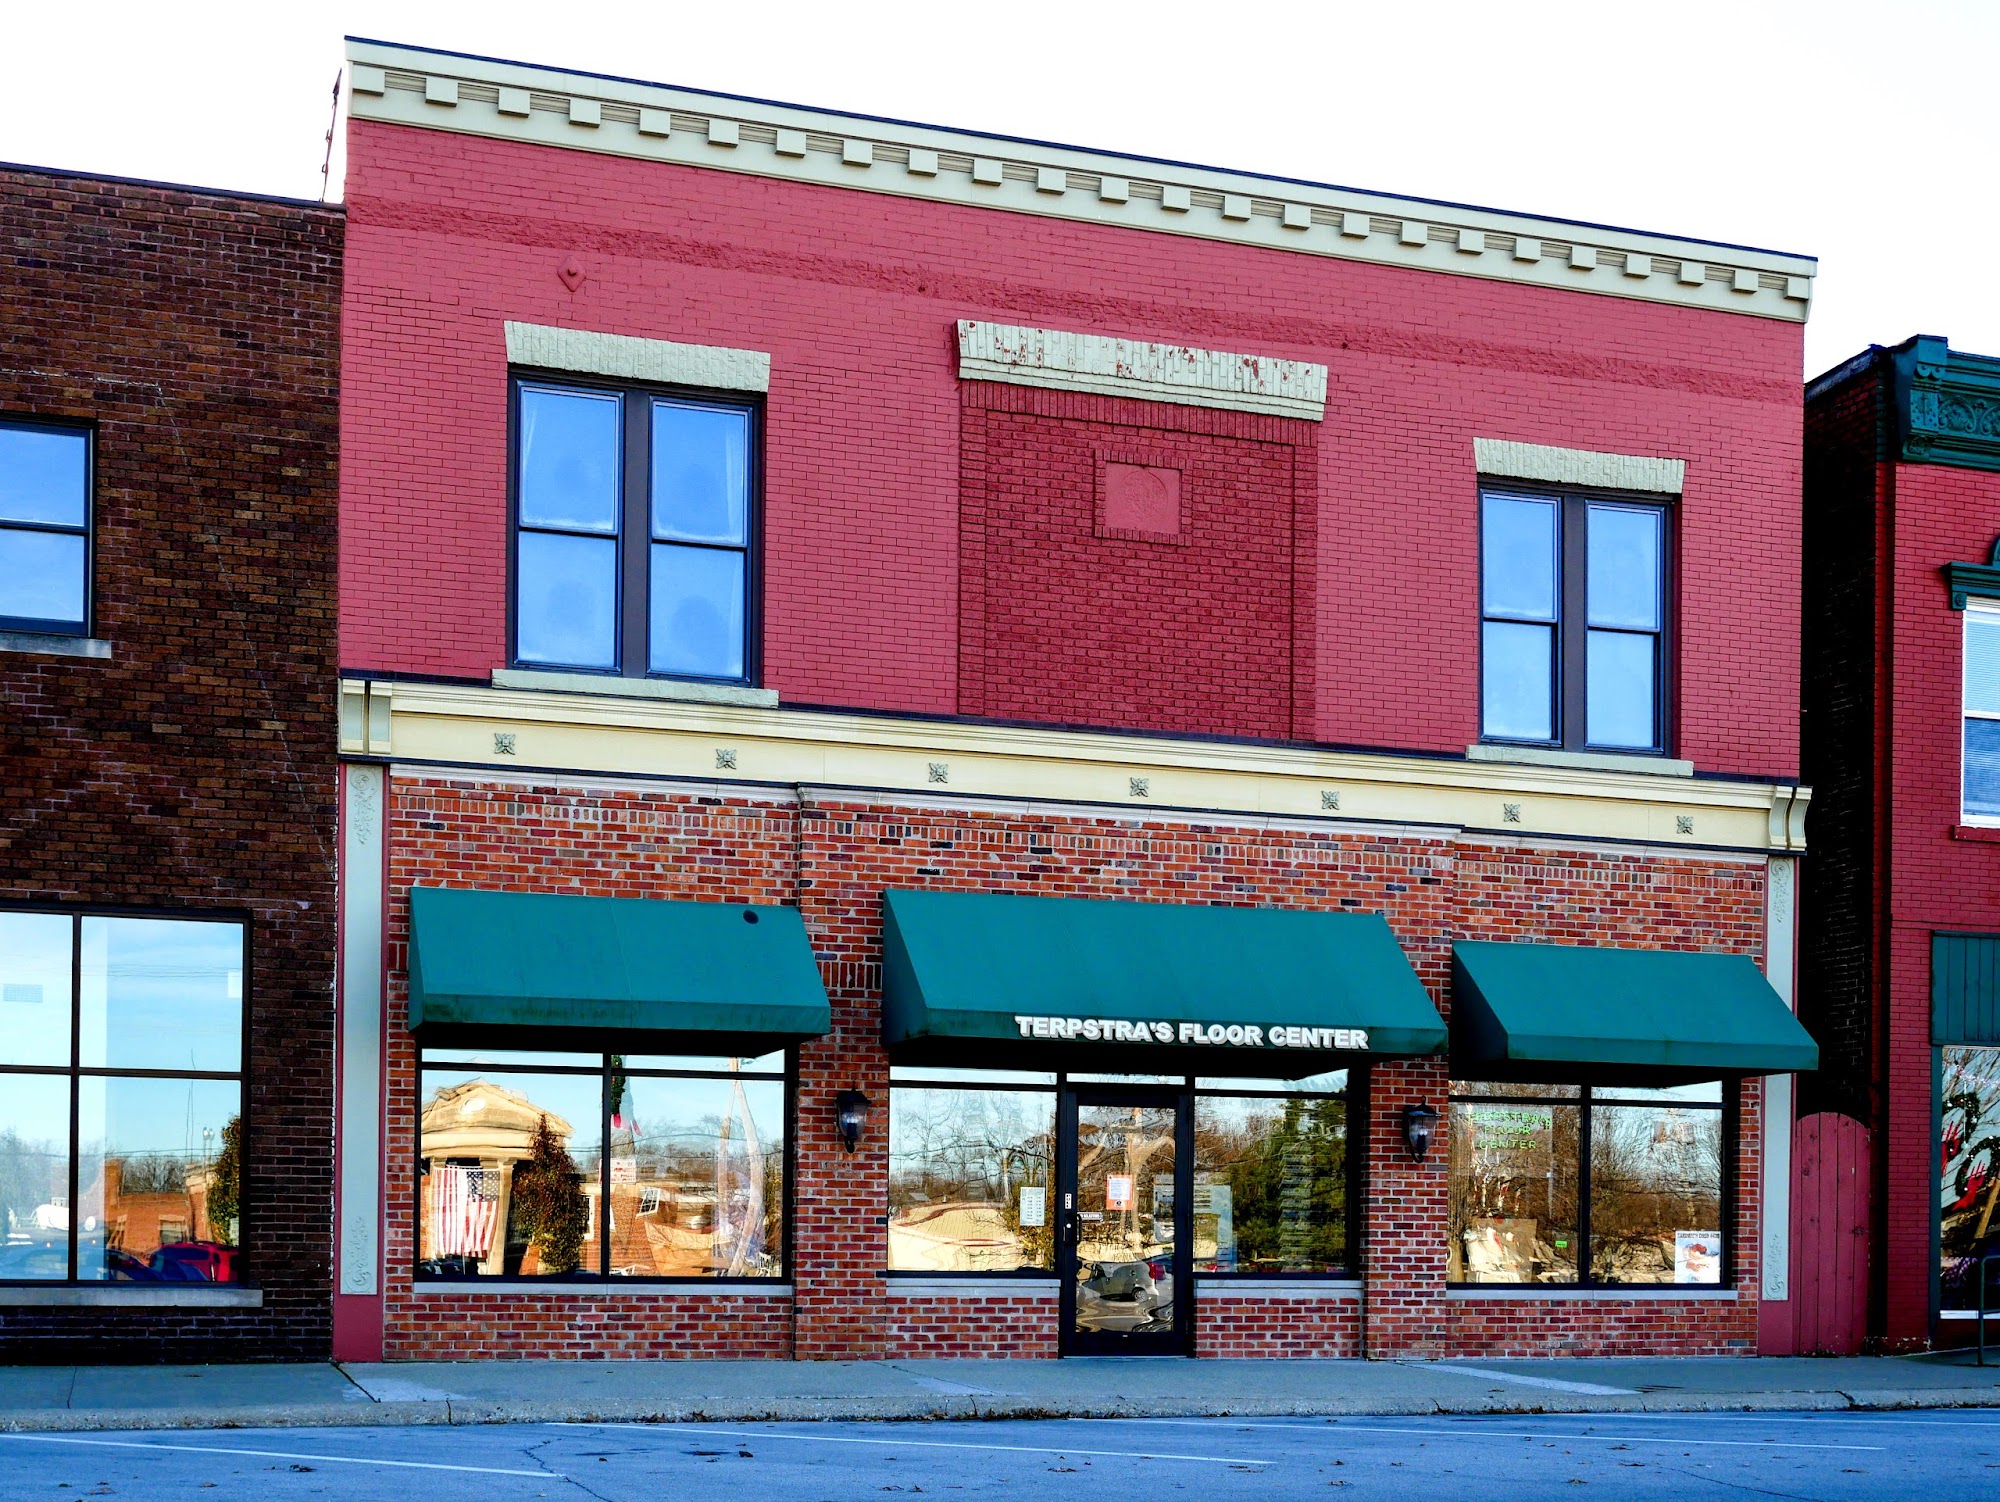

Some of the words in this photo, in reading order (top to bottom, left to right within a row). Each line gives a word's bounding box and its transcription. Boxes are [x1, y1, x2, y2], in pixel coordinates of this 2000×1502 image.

[1014, 1015, 1174, 1042] TERPSTRA'S
[1179, 1023, 1264, 1046] FLOOR
[1268, 1026, 1369, 1050] CENTER
[1479, 1139, 1537, 1150] CENTER
